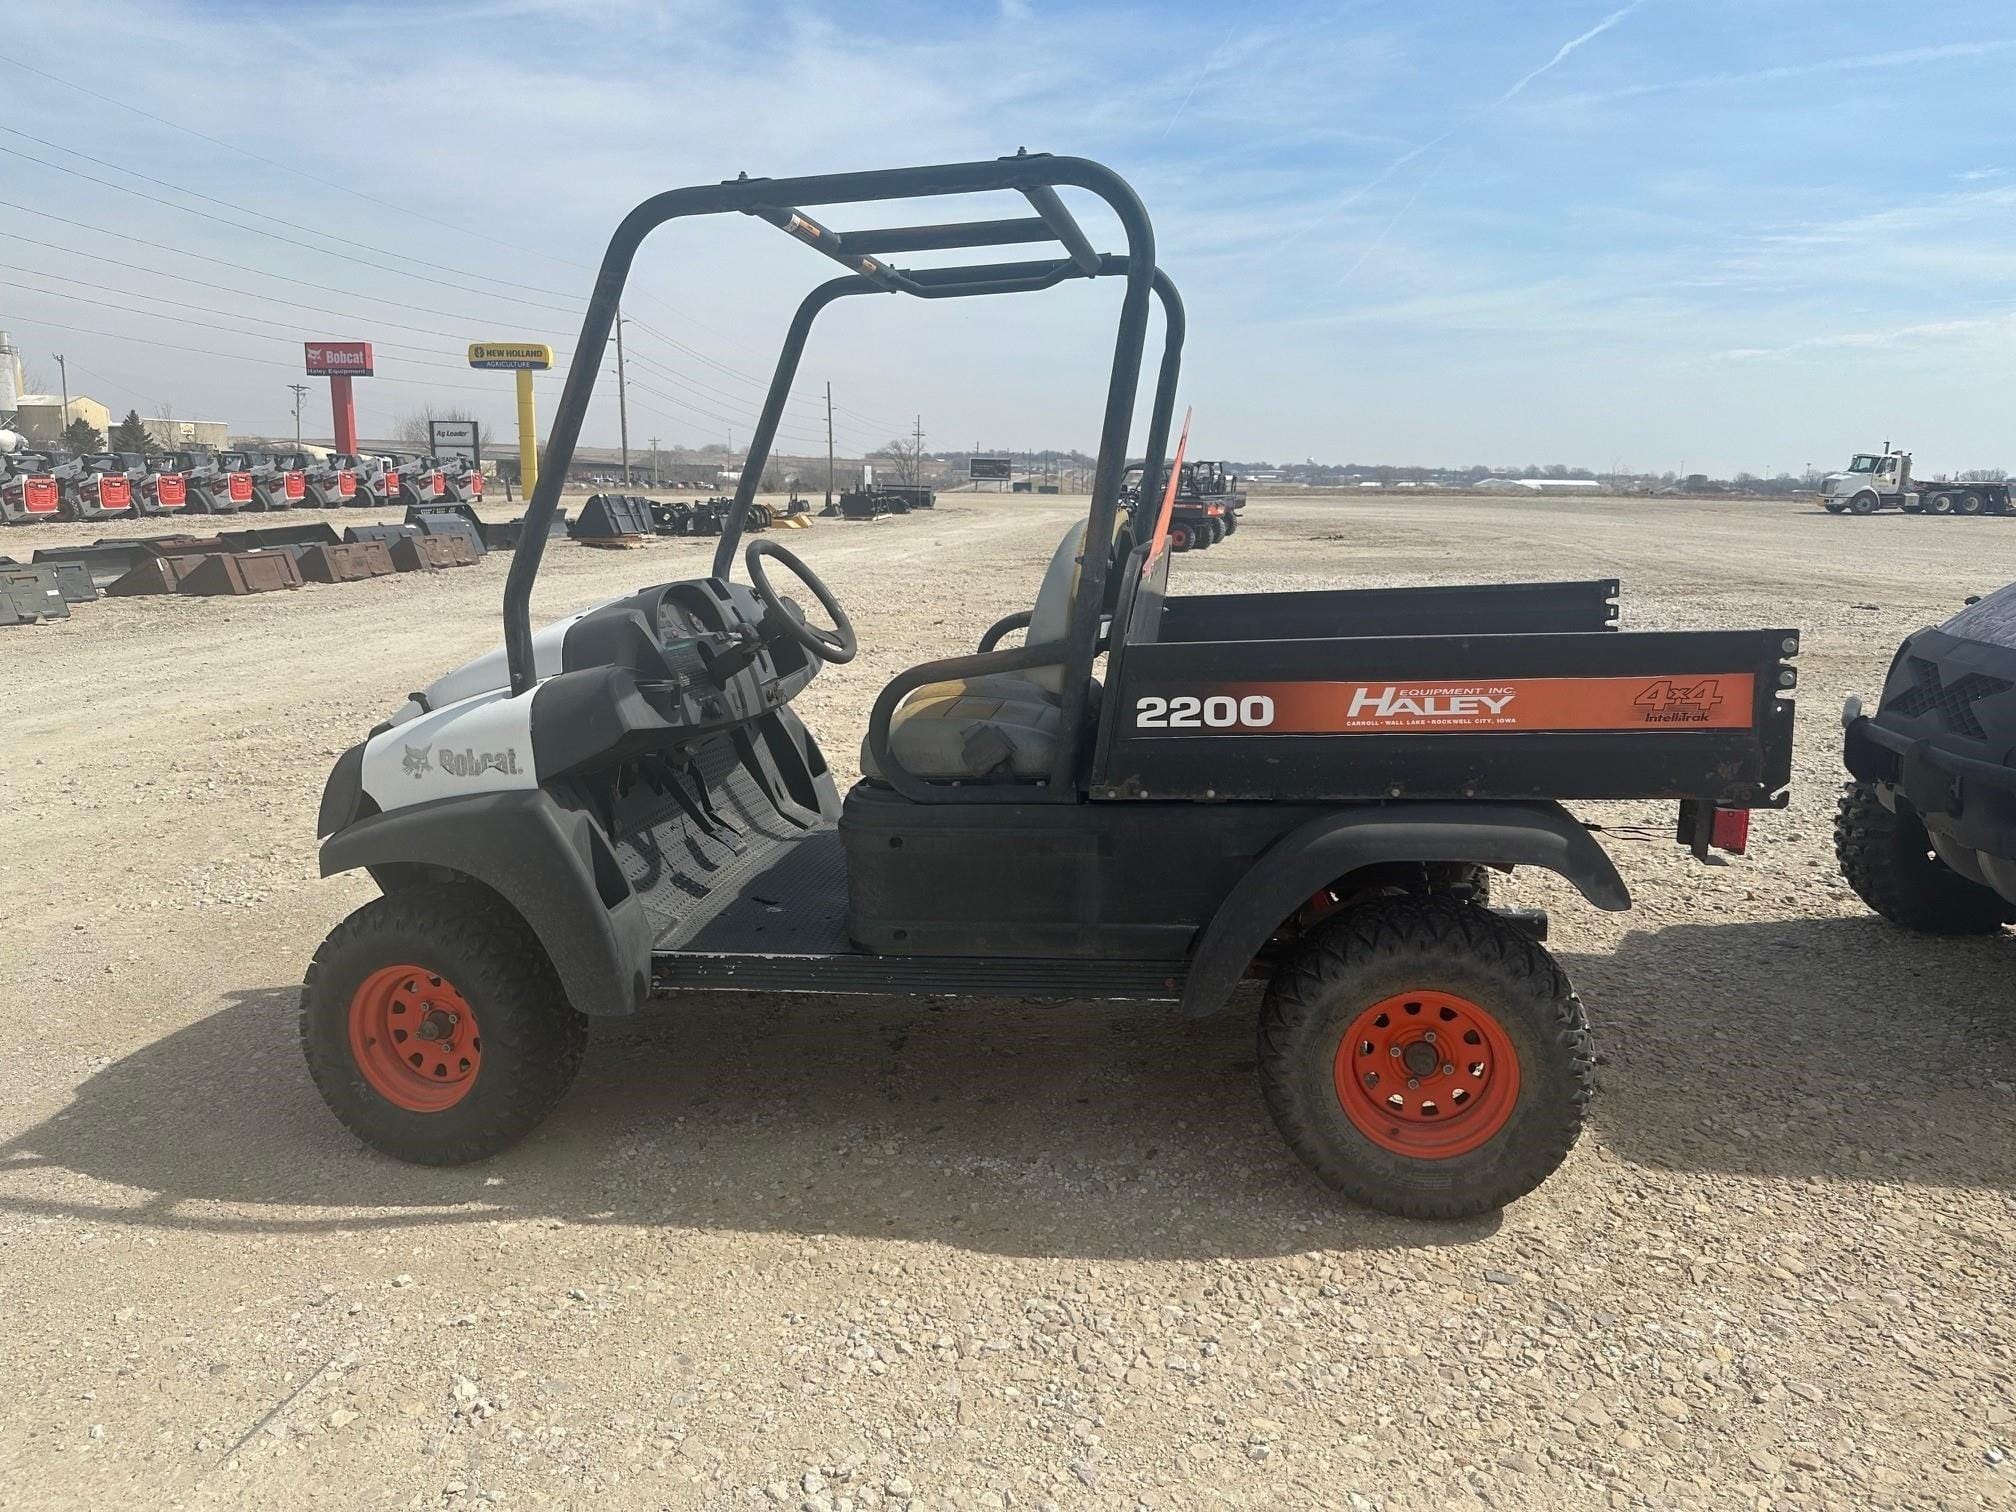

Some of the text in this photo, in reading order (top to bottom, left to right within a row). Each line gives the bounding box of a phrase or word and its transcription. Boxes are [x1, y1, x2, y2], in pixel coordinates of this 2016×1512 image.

[326, 350, 365, 364] Bobcat
[486, 349, 543, 358] NEW HOLLAND
[1399, 686, 1517, 696] EQUIPMENT INC.
[1633, 679, 1724, 712] 4x4
[1136, 695, 1275, 728] 2200
[1346, 686, 1516, 718] HALEY
[1645, 712, 1710, 722] IntelliTrak
[438, 748, 517, 777] Bobcat
